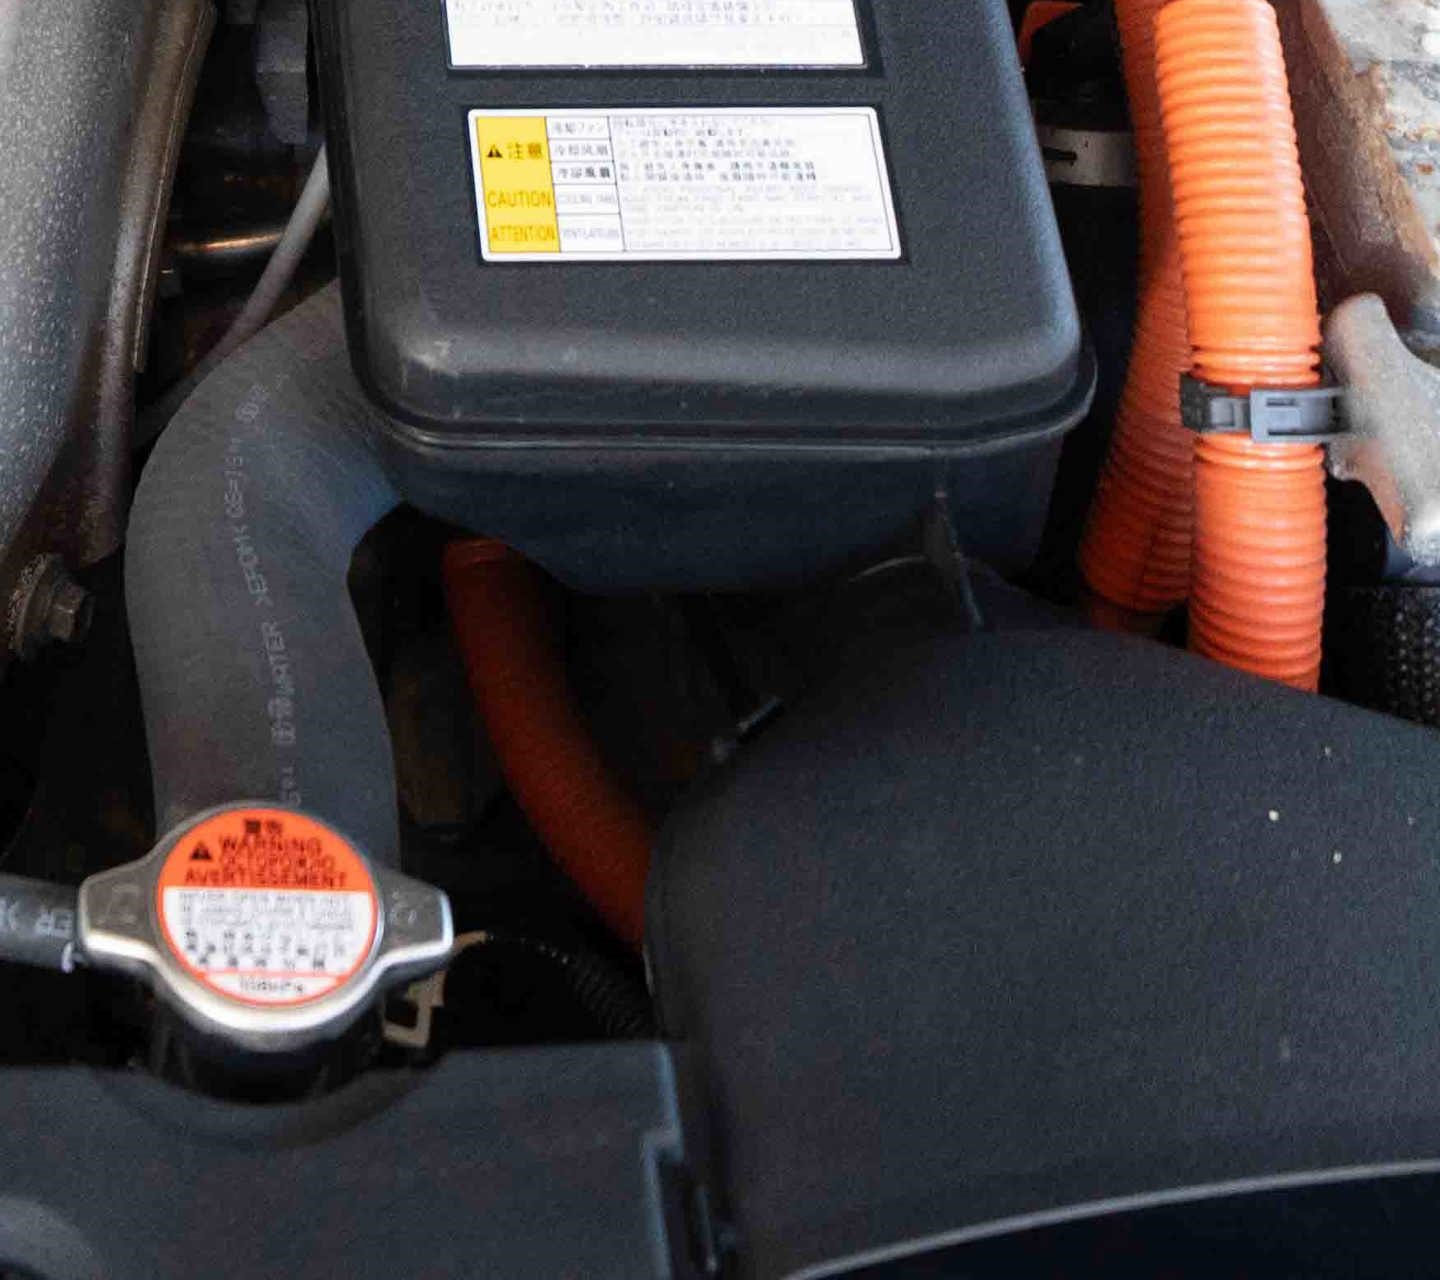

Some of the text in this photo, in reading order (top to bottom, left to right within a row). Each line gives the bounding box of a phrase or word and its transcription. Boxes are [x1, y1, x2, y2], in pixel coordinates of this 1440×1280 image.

[487, 190, 552, 208] CAUTION
[490, 223, 557, 242] ATTENTION
[219, 837, 323, 856] WARNING
[185, 868, 349, 887] AVERTISSEMENT
